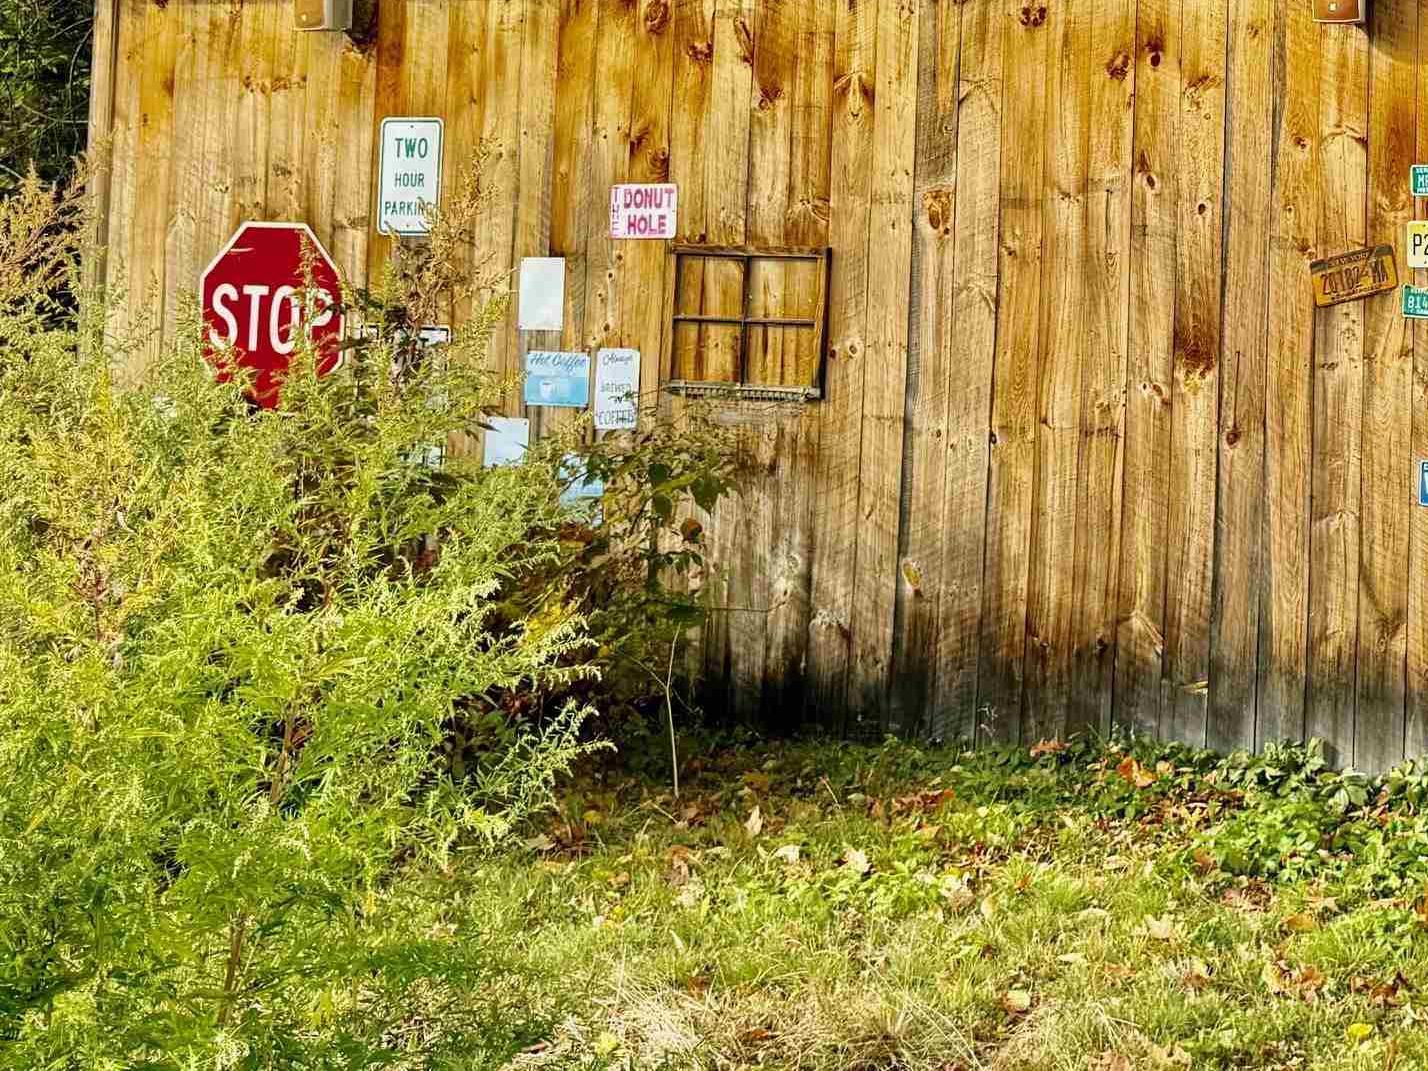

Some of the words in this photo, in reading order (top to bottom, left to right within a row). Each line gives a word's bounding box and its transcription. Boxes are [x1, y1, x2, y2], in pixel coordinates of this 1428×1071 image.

[394, 137, 428, 159] TWO
[394, 172, 425, 188] HOUR
[624, 188, 675, 209] DONUT
[627, 214, 667, 235] HOLE
[208, 282, 335, 355] STOP
[529, 352, 551, 366] Hot
[551, 353, 587, 374] Coffee
